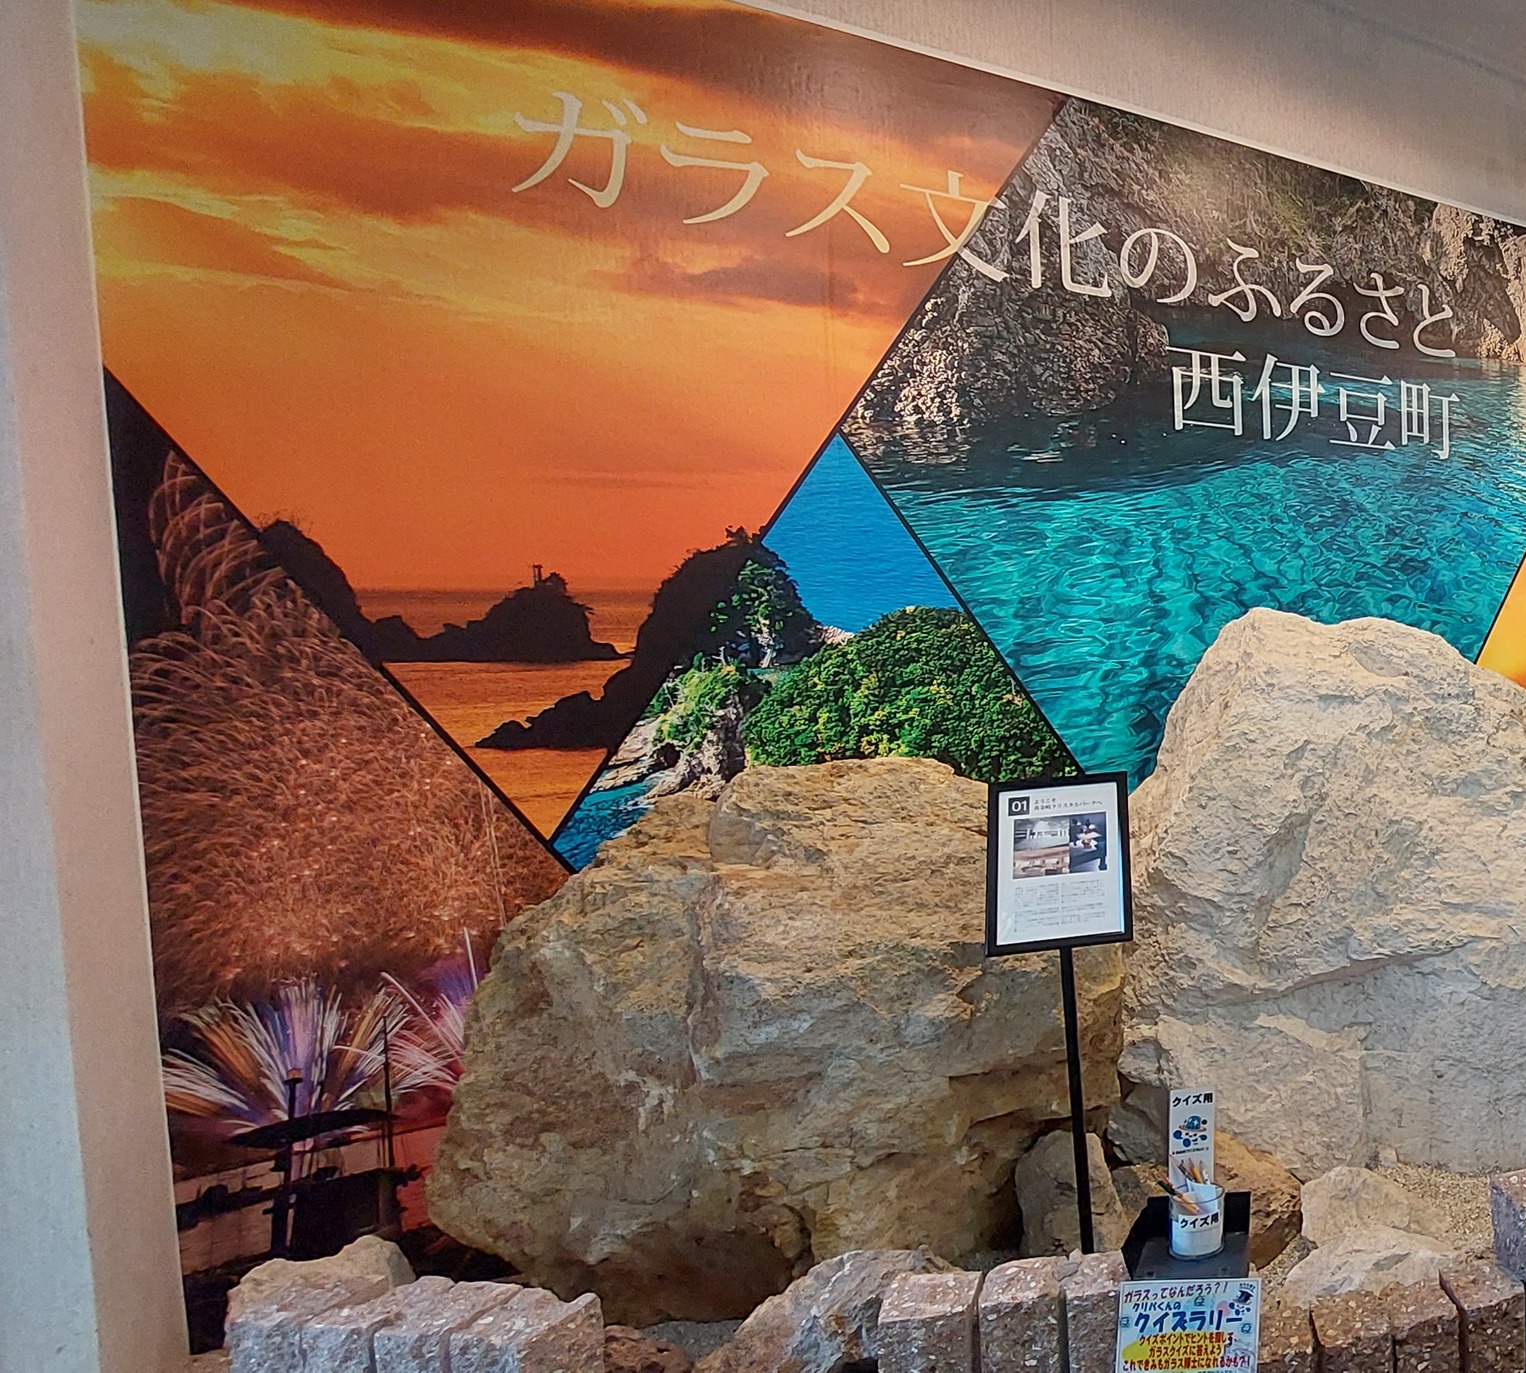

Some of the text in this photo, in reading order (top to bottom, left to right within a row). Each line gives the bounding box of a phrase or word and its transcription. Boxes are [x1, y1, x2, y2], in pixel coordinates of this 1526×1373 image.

[513, 93, 1457, 358] ガラス文化のふるさと
[1166, 345, 1460, 460] 西伊豆町
[1012, 801, 1028, 812] 01
[1172, 1092, 1214, 1107] クイズ用
[1180, 1211, 1219, 1229] クイズ用
[1134, 1310, 1243, 1333] クイズラリー
